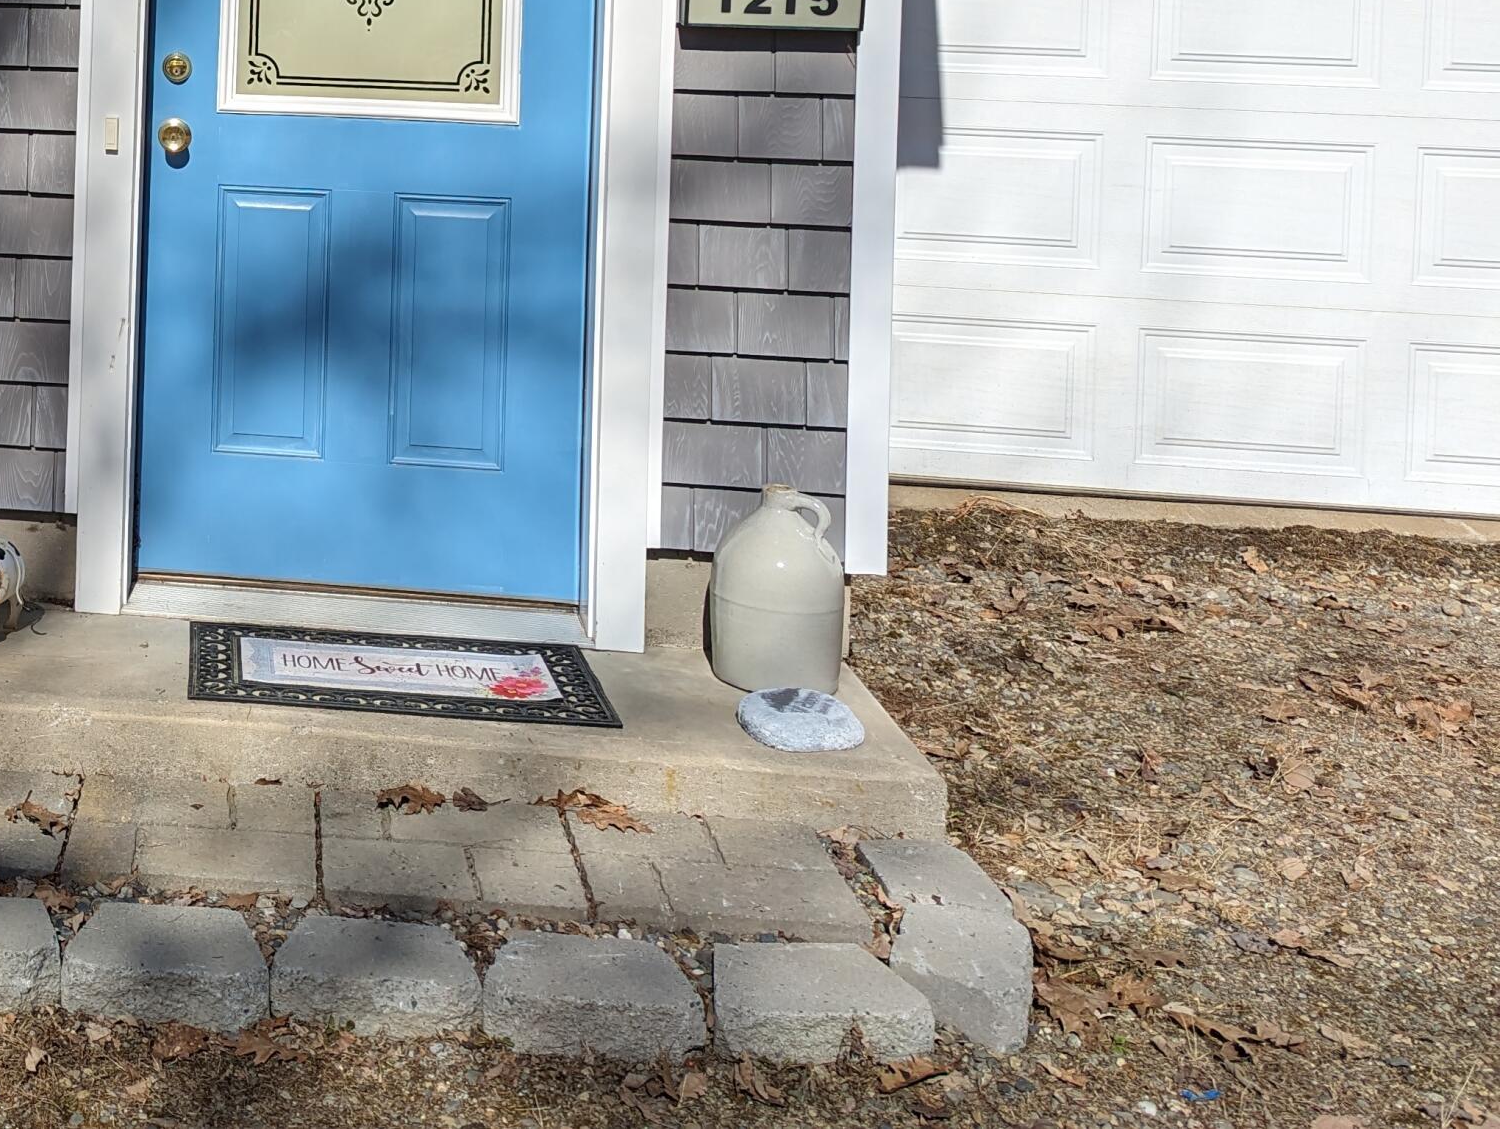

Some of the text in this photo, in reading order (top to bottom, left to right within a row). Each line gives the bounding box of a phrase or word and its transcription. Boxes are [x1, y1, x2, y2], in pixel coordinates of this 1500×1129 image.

[282, 653, 502, 682] HOME Sweet HOME
